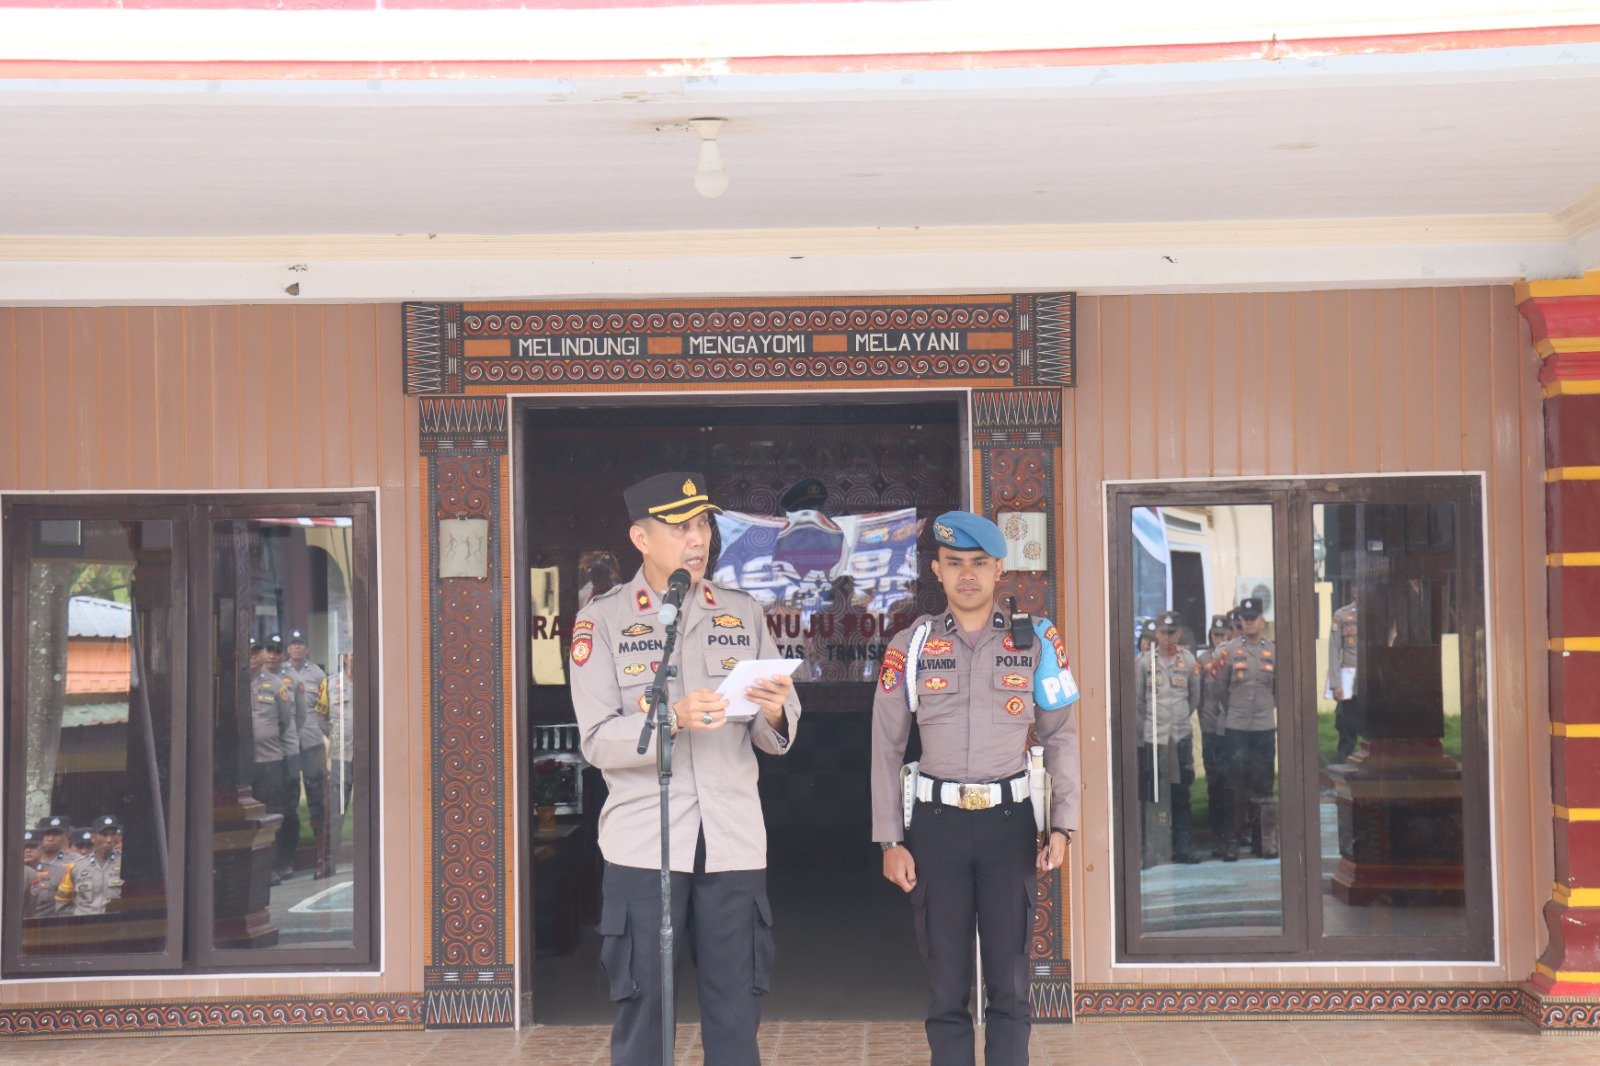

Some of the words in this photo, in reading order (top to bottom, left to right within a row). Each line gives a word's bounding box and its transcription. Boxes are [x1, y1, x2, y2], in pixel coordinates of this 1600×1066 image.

[518, 336, 640, 357] MELINDUNGI
[689, 334, 806, 355] MENGAYOMI
[855, 332, 960, 352] MELAYANI
[618, 639, 664, 654] MADEN
[707, 634, 751, 647] POLRI
[995, 655, 1033, 668] POLRI
